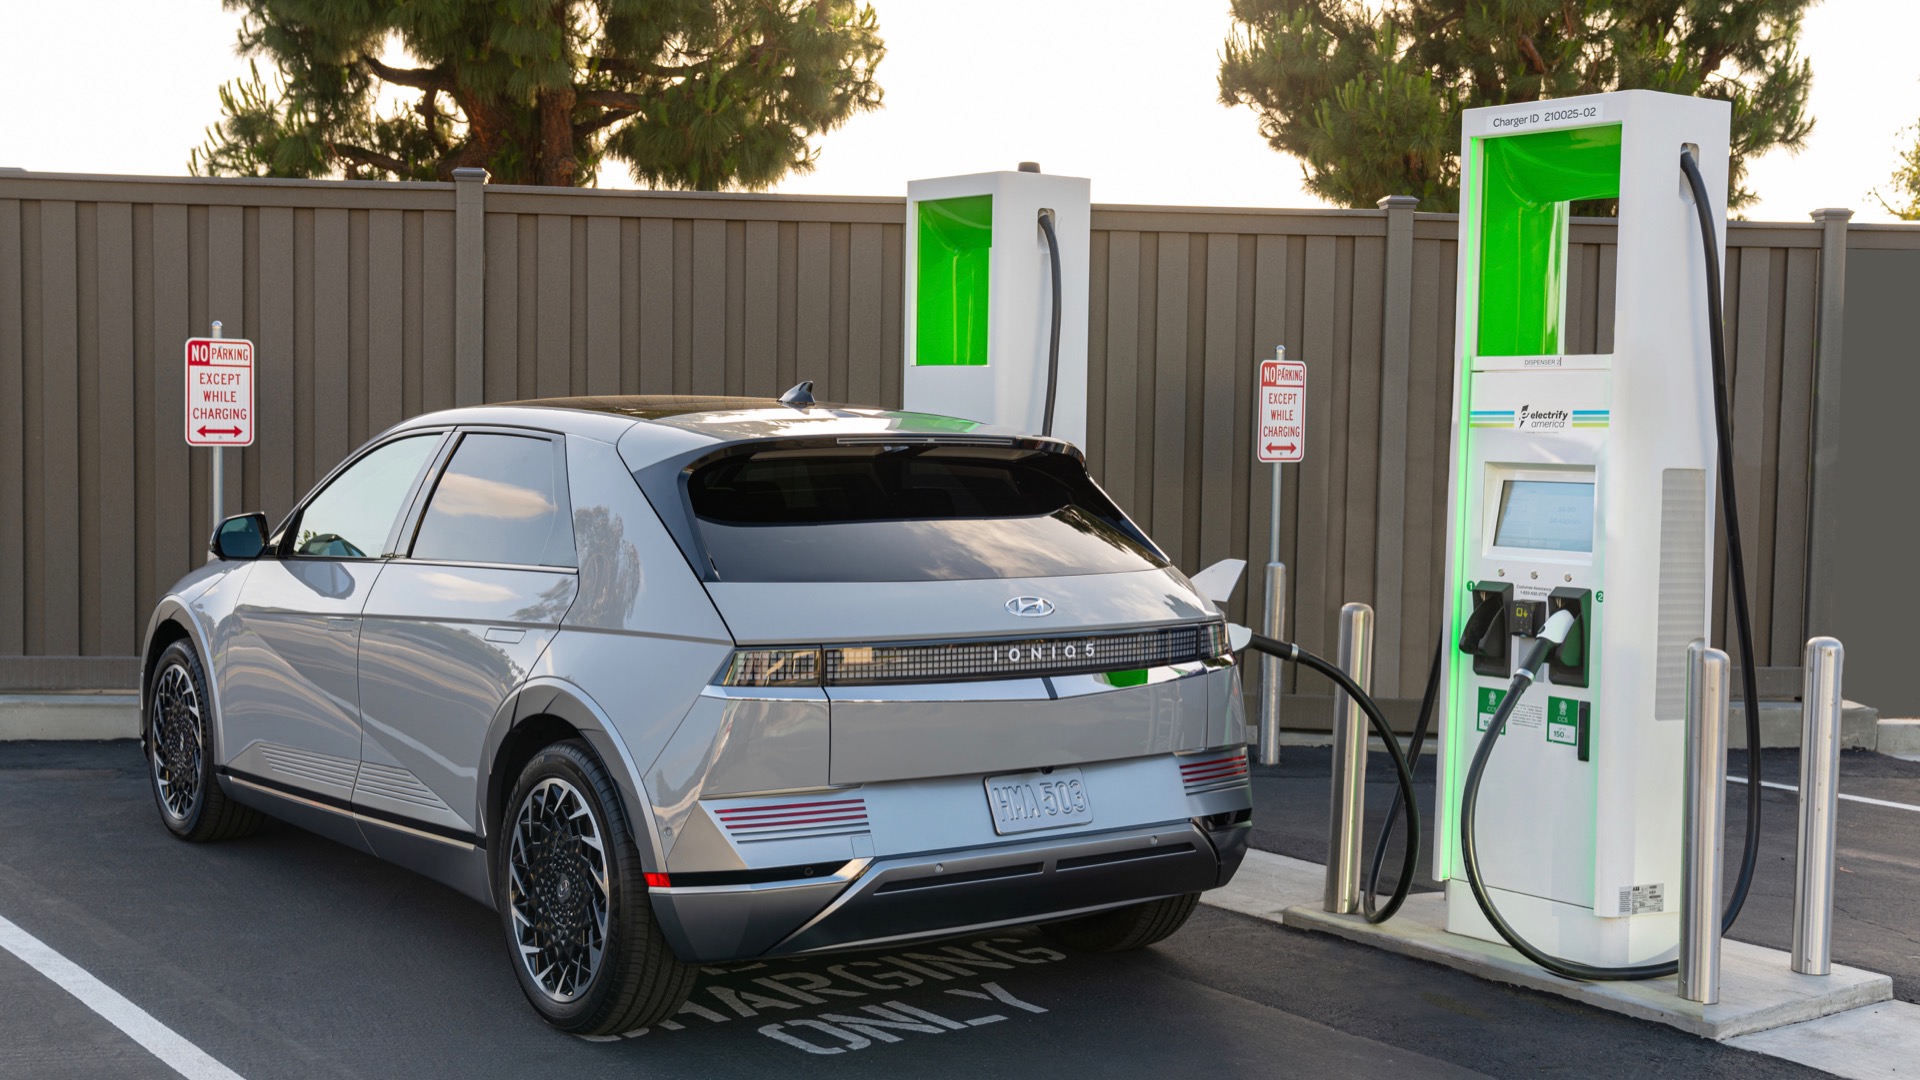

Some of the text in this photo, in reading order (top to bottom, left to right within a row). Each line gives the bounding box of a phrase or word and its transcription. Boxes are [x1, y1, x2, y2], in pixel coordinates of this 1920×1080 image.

[1493, 107, 1596, 128] Charger ID 210025-02
[191, 344, 249, 363] NO PARKING
[199, 372, 242, 385] EXCEPT
[1264, 366, 1303, 383] NO PARKING
[203, 390, 237, 403] WHILE
[1268, 393, 1297, 404] EXCEPT
[192, 407, 247, 421] CHARGING
[1271, 410, 1293, 420] WHILE
[1530, 411, 1568, 420] electrify
[1263, 426, 1300, 437] CHARGING
[993, 643, 1095, 663] IONIQ 5
[1486, 705, 1497, 713] CC
[993, 779, 1087, 822] HMA 503
[757, 981, 1050, 1056] ONLY
